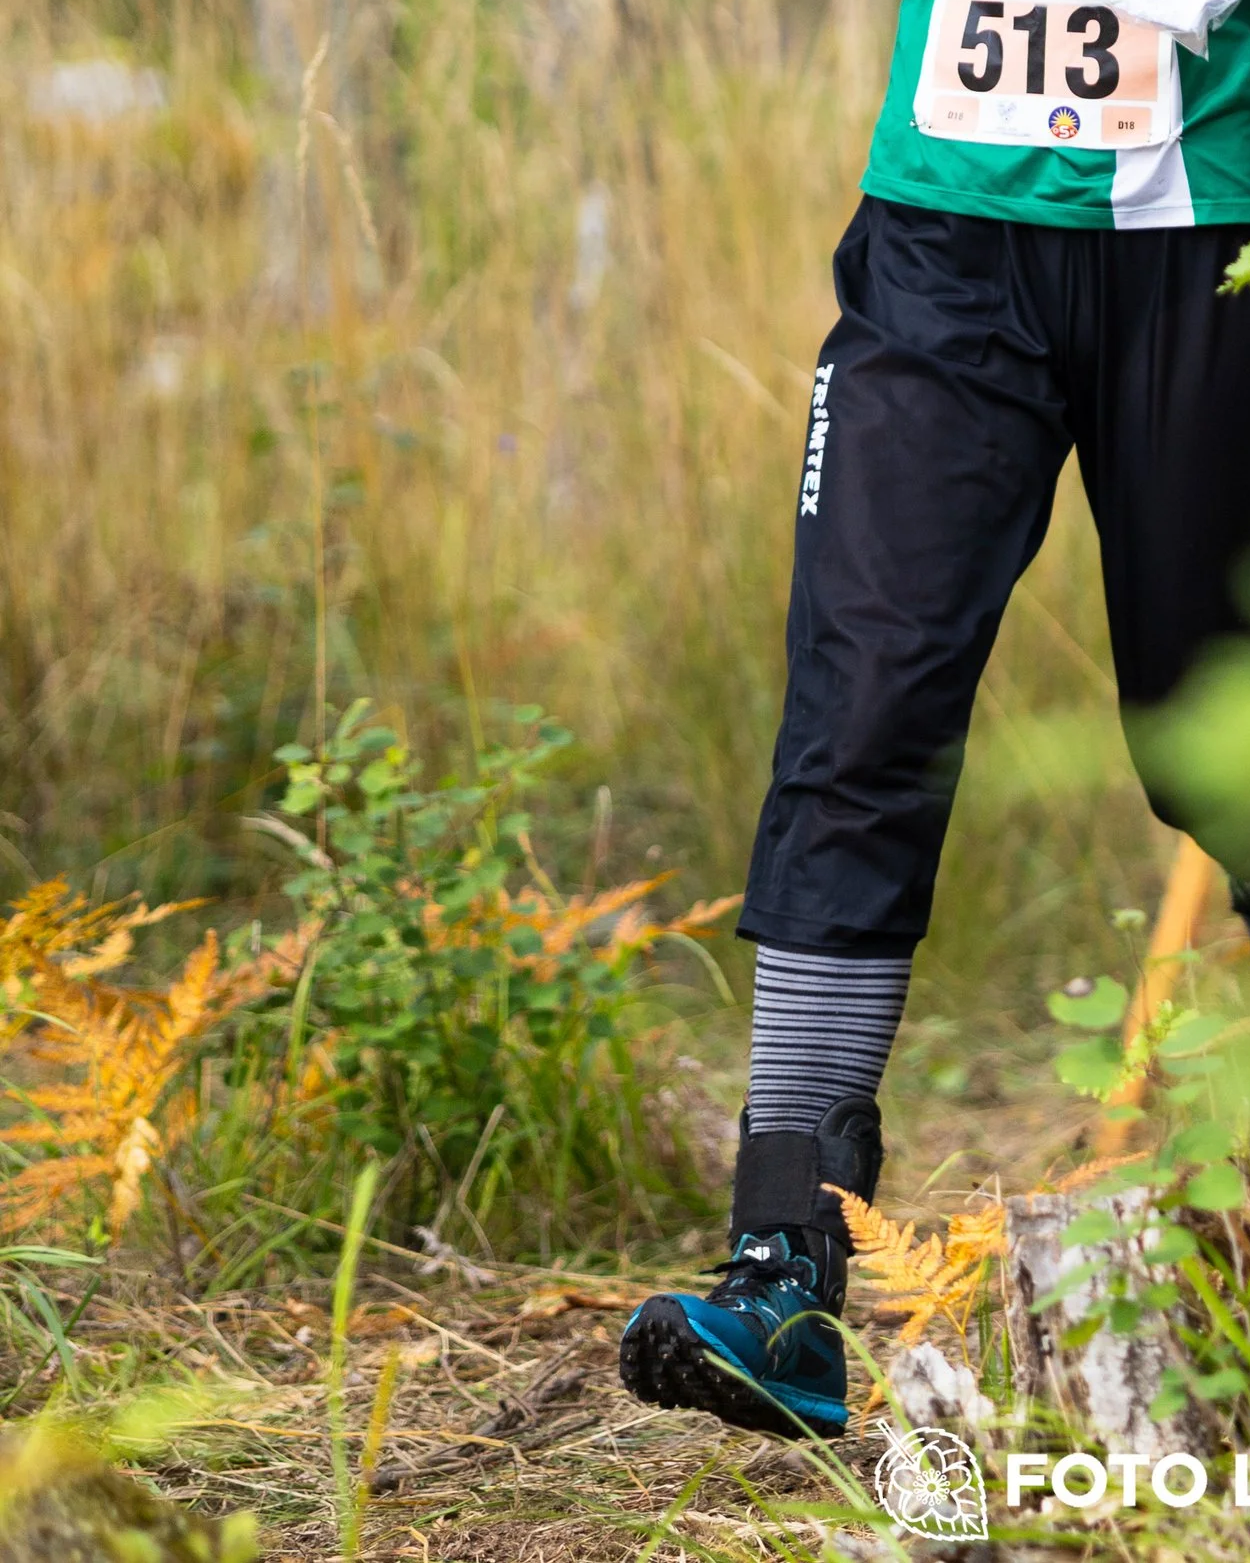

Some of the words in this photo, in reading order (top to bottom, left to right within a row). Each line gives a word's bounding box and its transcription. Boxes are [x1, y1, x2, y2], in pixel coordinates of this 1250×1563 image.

[957, 0, 1120, 99] 513
[1117, 120, 1135, 131] D18
[801, 363, 835, 517] TRIMTEX
